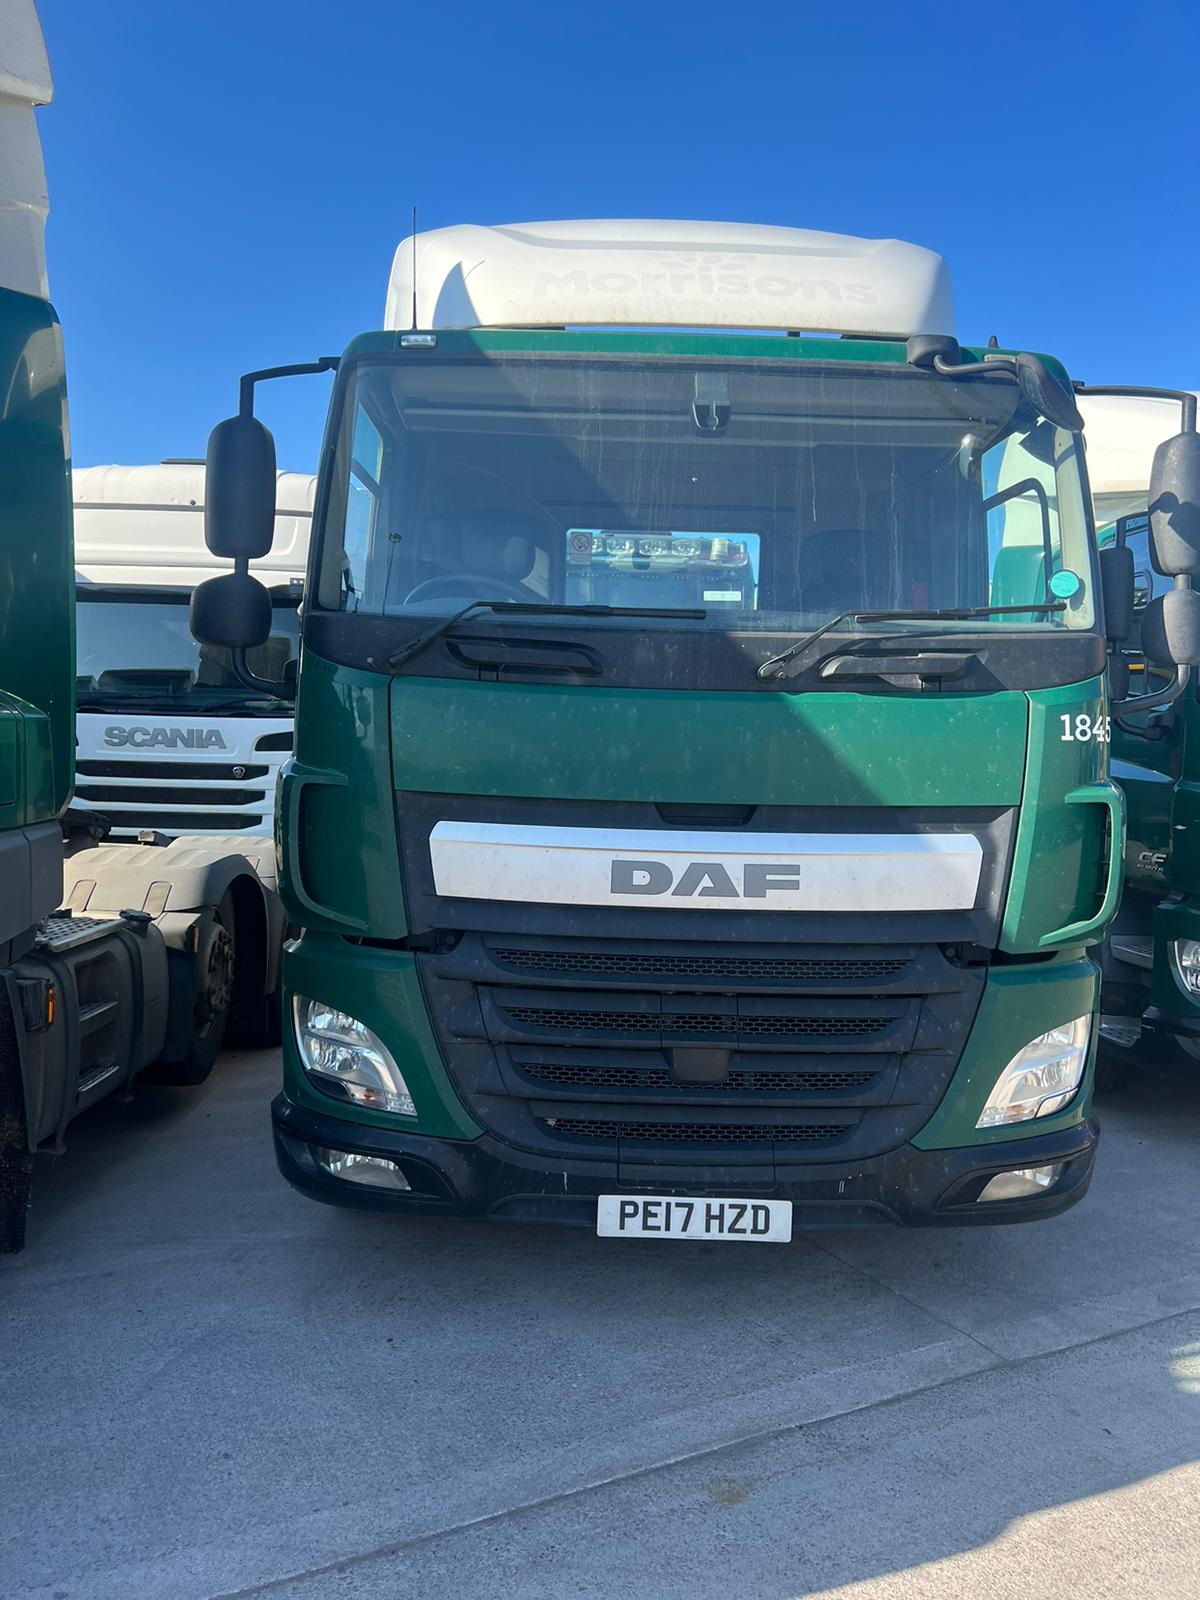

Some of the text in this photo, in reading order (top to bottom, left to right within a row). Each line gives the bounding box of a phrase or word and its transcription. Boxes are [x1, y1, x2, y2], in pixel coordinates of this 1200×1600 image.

[104, 726, 227, 749] SCANIA
[1060, 714, 1111, 742] 1845
[1139, 851, 1167, 865] CF
[611, 860, 801, 898] DAF
[619, 1200, 770, 1235] PE17 HZD
